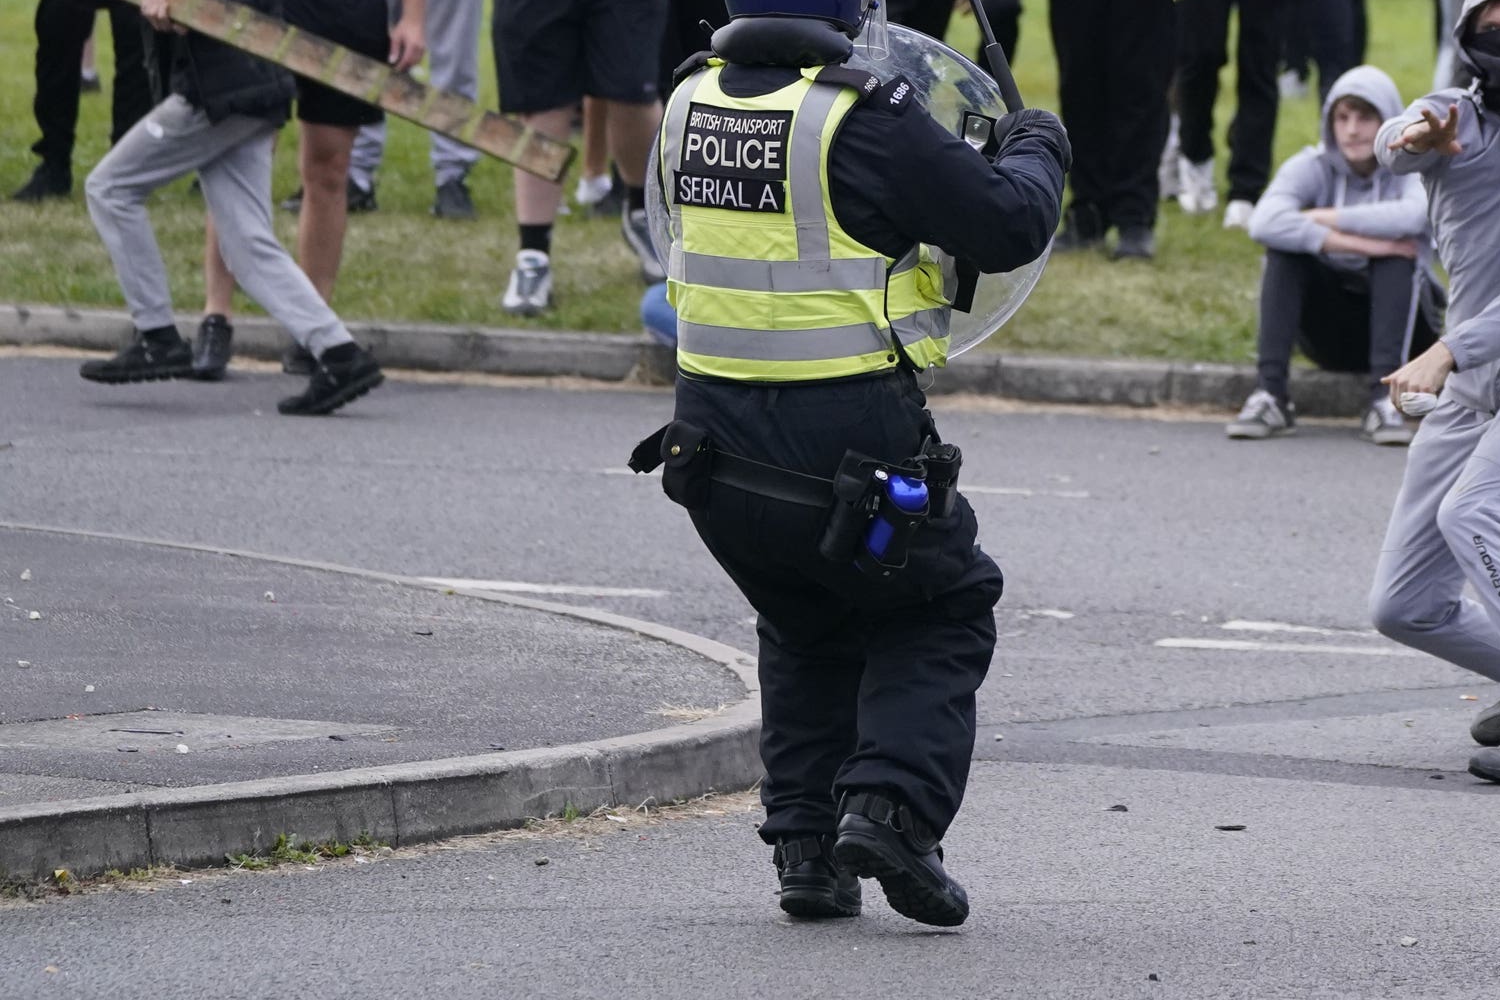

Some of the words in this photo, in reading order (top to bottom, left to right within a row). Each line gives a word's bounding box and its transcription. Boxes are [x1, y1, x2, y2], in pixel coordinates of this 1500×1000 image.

[889, 81, 910, 105] 1686
[689, 111, 723, 131] BRITISH
[722, 116, 786, 136] TRANSPORT
[685, 132, 782, 170] POLICE
[679, 175, 752, 209] SERIAL
[758, 183, 779, 210] A
